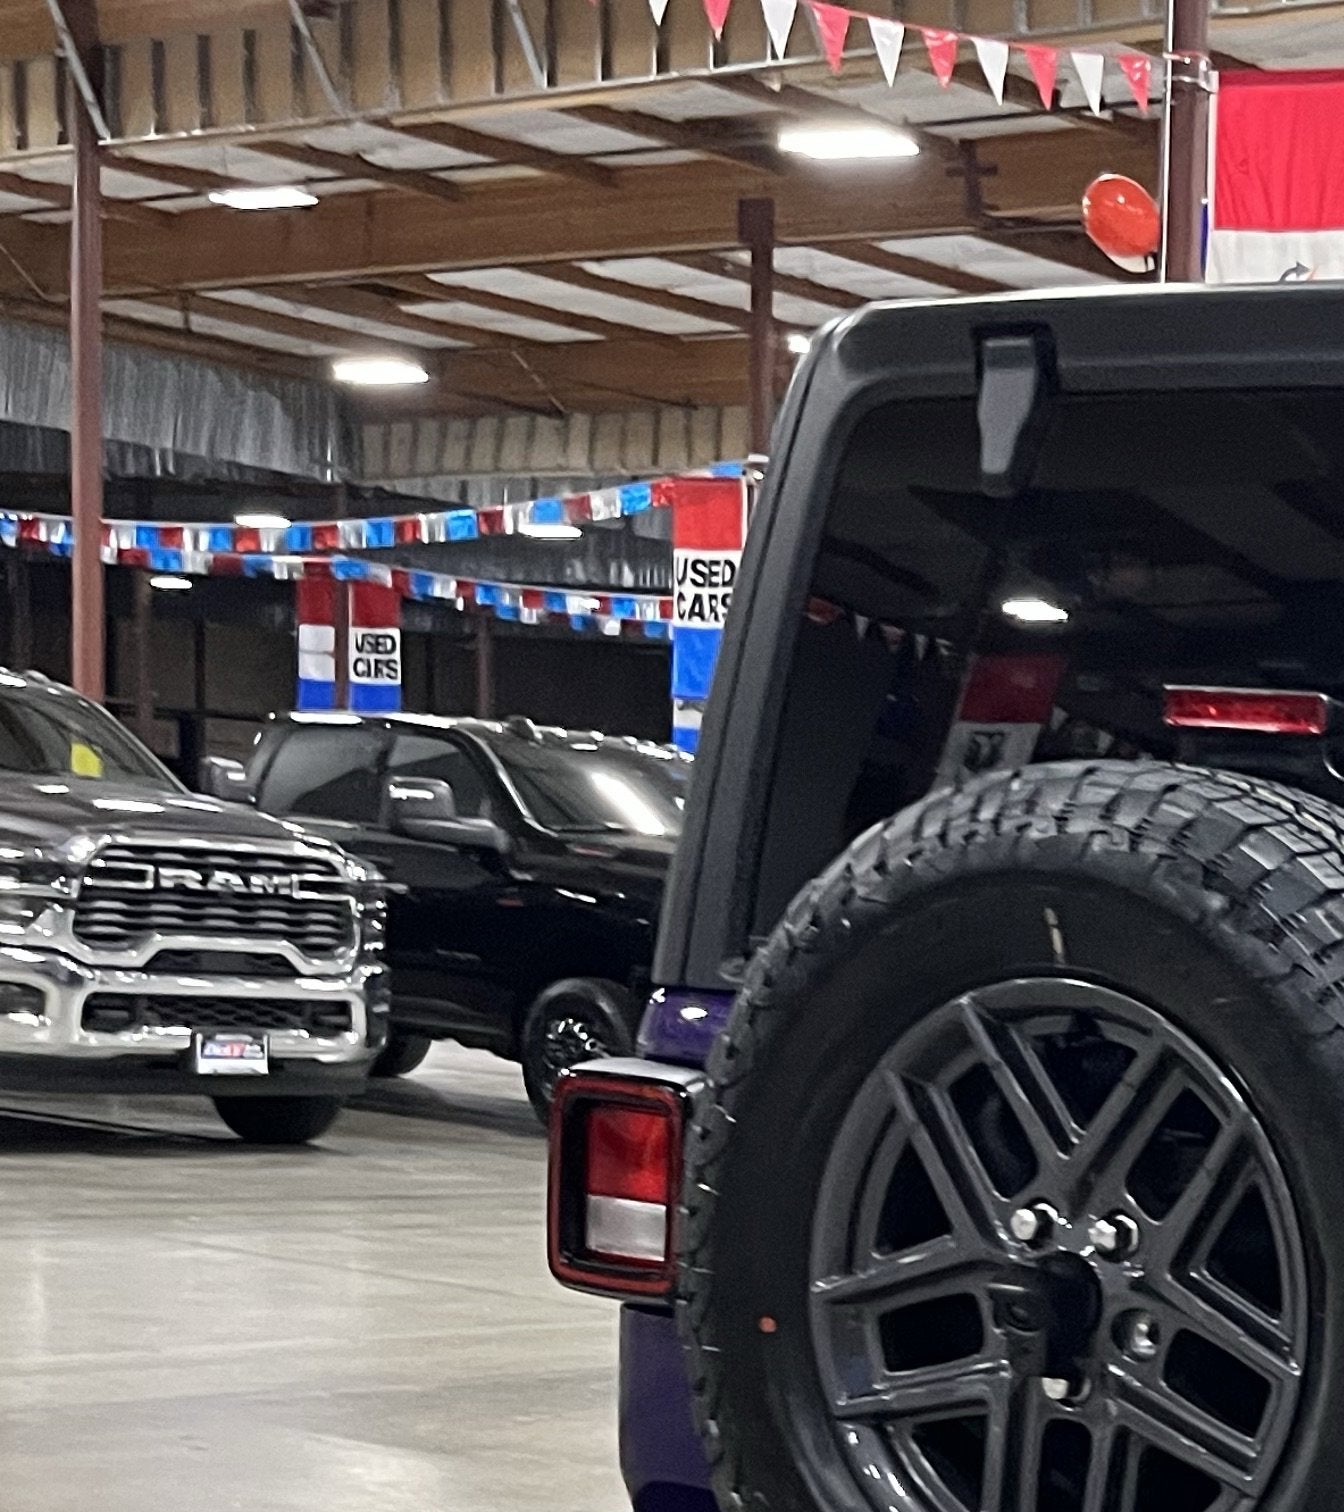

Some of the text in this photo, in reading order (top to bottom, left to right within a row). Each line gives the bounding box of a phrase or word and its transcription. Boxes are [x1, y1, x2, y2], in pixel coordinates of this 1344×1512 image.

[677, 557, 736, 588] USED
[355, 633, 397, 654] USED
[158, 867, 292, 894] RAM
